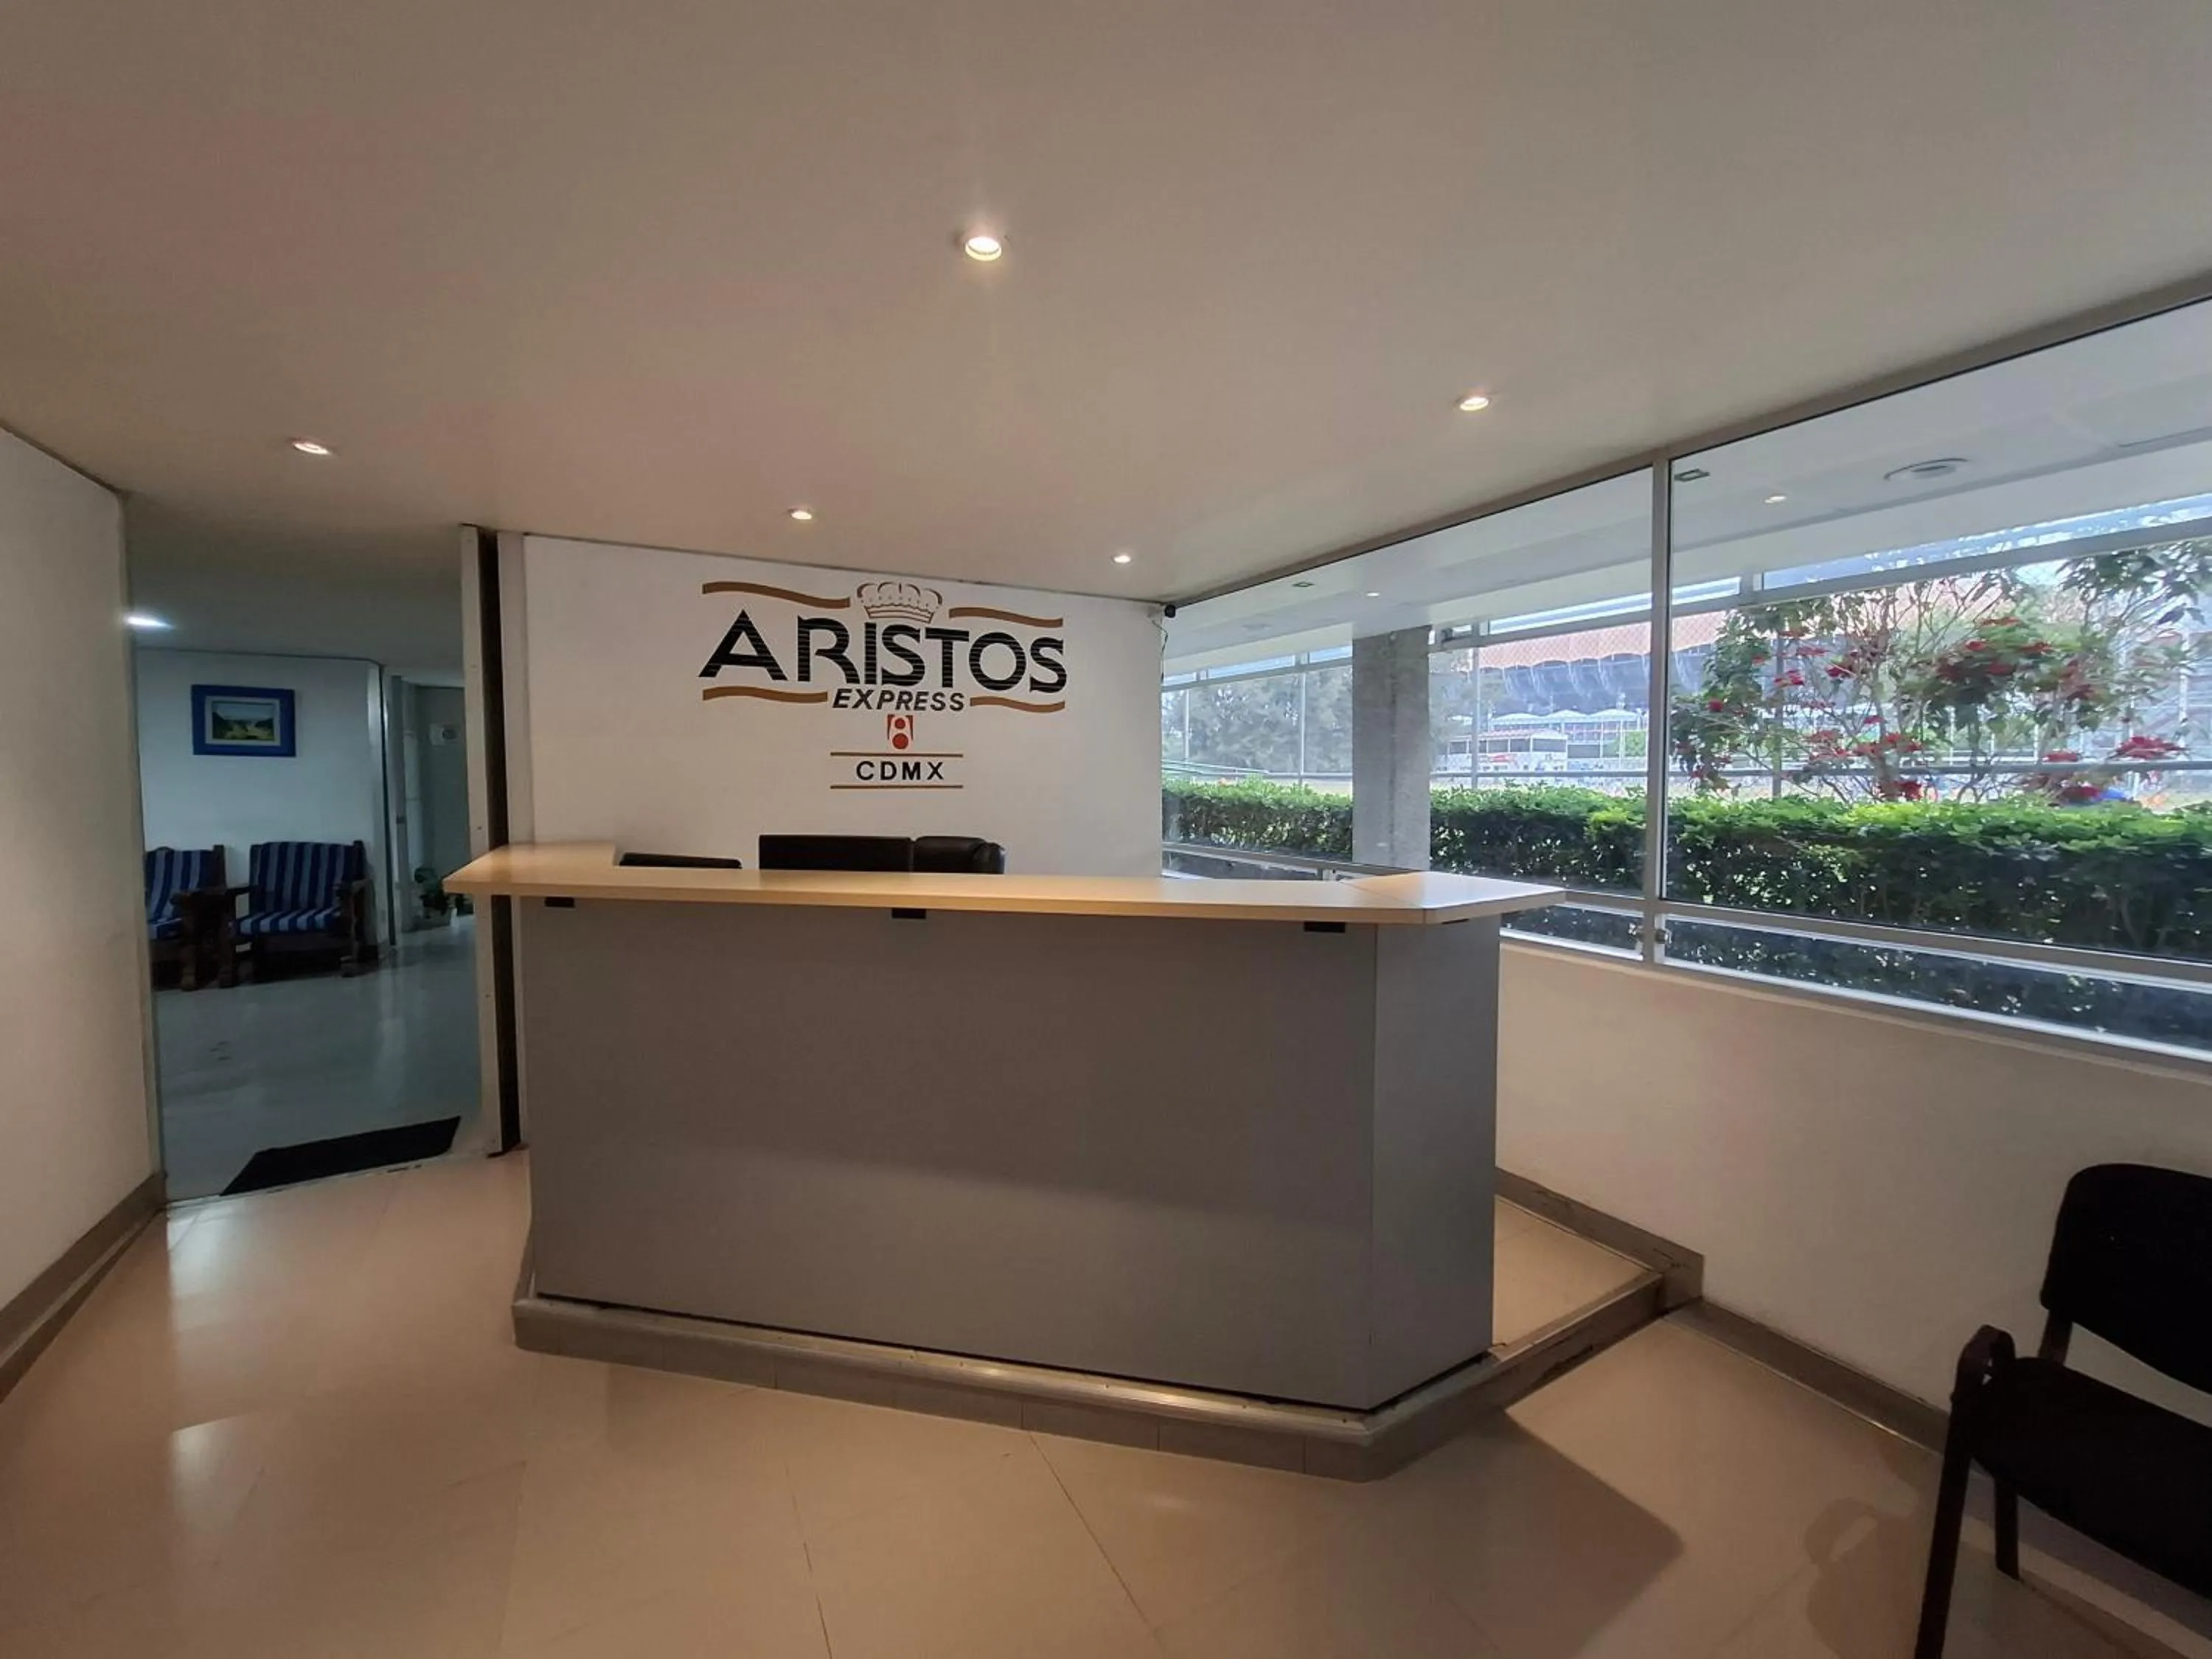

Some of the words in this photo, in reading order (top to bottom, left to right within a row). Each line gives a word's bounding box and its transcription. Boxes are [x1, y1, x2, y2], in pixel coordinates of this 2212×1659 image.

[698, 609, 1067, 694] ARISTOS
[832, 688, 966, 712] EXPRESS
[855, 760, 945, 782] CDMX
